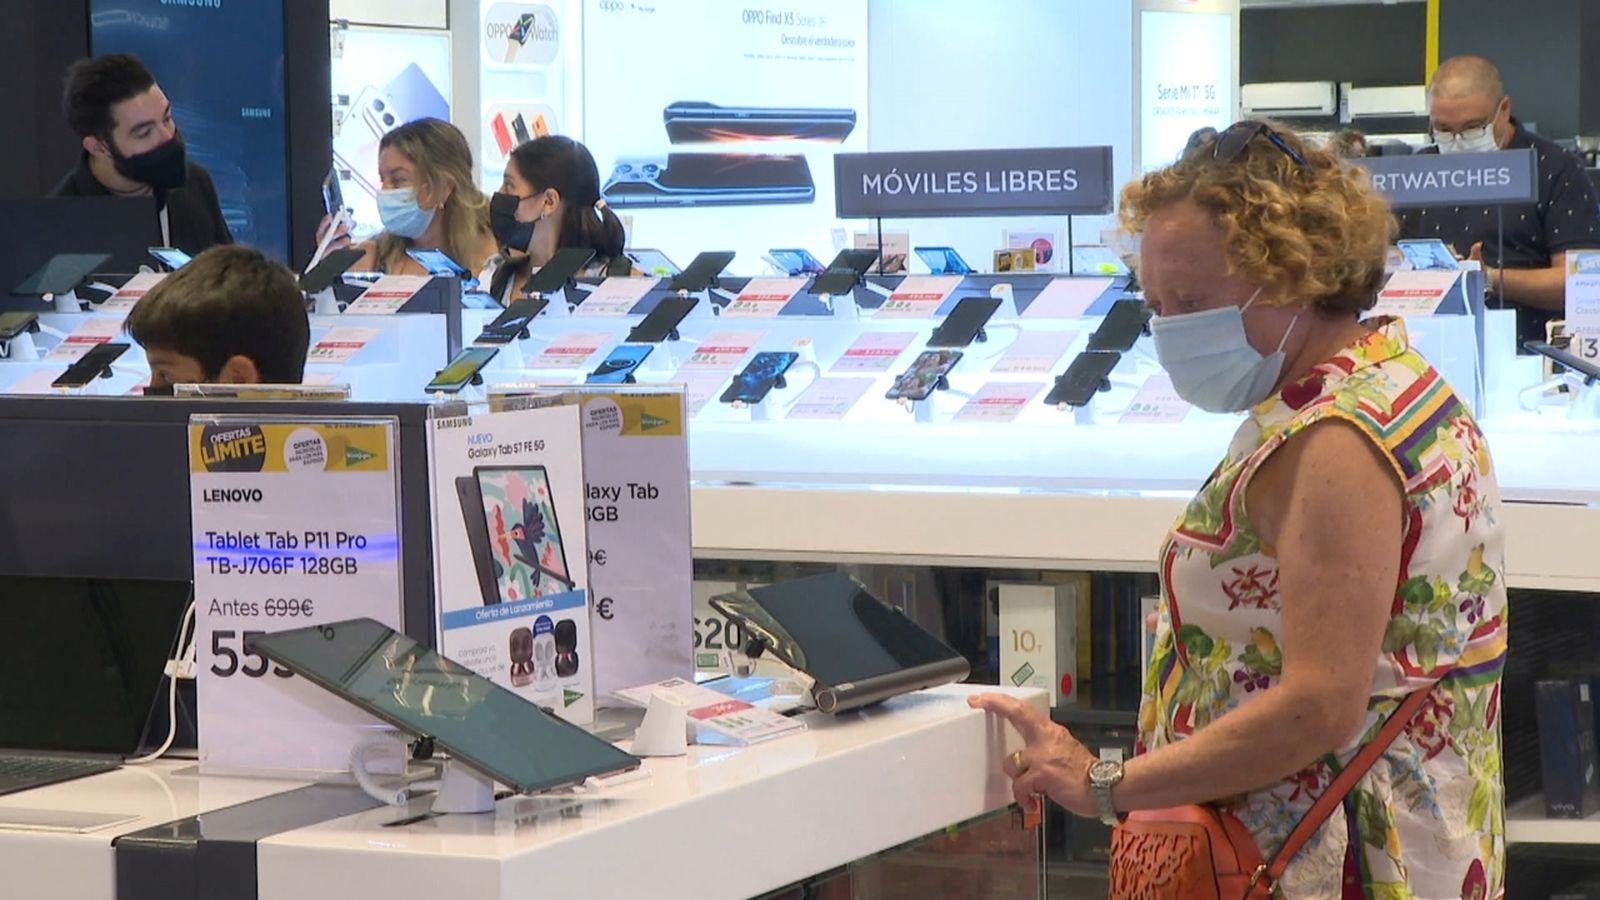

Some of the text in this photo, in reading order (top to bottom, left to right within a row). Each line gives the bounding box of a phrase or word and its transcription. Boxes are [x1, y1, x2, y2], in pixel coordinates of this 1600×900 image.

[742, 9, 764, 24] OPPO
[766, 10, 782, 24] Find
[784, 11, 794, 25] X3
[487, 22, 512, 40] OPPO
[241, 107, 271, 117] SAMSUNG
[863, 168, 1078, 195] MÓVILES LIBRES
[590, 406, 617, 416] OFERTAS
[437, 417, 473, 430] SAMSUNG
[210, 427, 252, 443] OFERTAS
[293, 438, 321, 449] OFERTAS
[467, 433, 493, 445] NUEVO
[202, 435, 265, 464] LIMITE
[468, 446, 498, 459] Galaxy
[498, 444, 513, 455] Tab
[524, 440, 533, 452] FE
[203, 489, 263, 503] LENOVO
[627, 483, 659, 500] Tab
[205, 532, 367, 550] Tablet Tab P11 Pro
[207, 557, 358, 575] TB-J706F 128GB
[208, 598, 313, 617] Antes 699€
[475, 600, 554, 620] Oferta de Lanzamiento
[210, 630, 296, 678] 55
[1551, 803, 1575, 811] vivo
